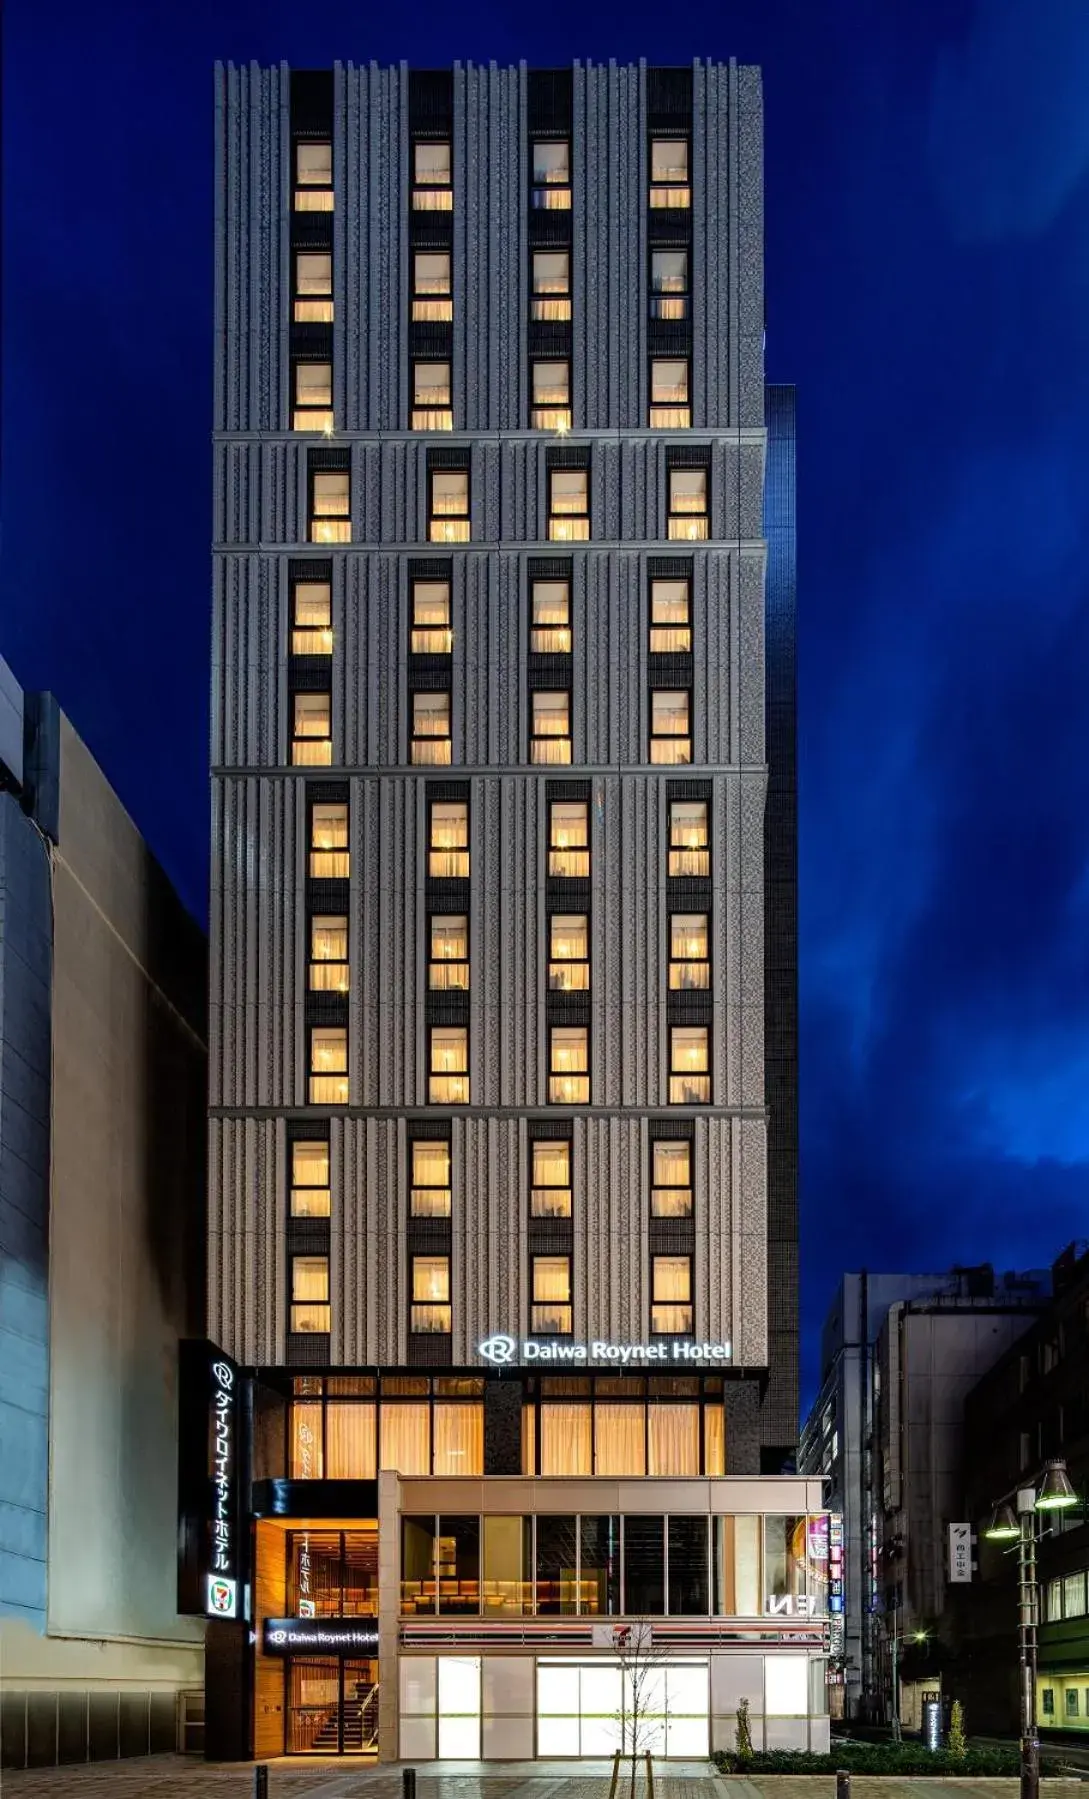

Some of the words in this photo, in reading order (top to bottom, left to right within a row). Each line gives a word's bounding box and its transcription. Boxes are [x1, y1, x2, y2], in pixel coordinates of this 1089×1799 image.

[523, 1341, 587, 1359] Daiwa
[592, 1341, 668, 1363] Roynet
[672, 1341, 731, 1359] Hotel
[214, 1390, 233, 1570] ダイワロイネットホテル
[288, 1632, 318, 1642] Daiwa
[318, 1632, 352, 1644] Roynet
[352, 1632, 379, 1642] Hotel
